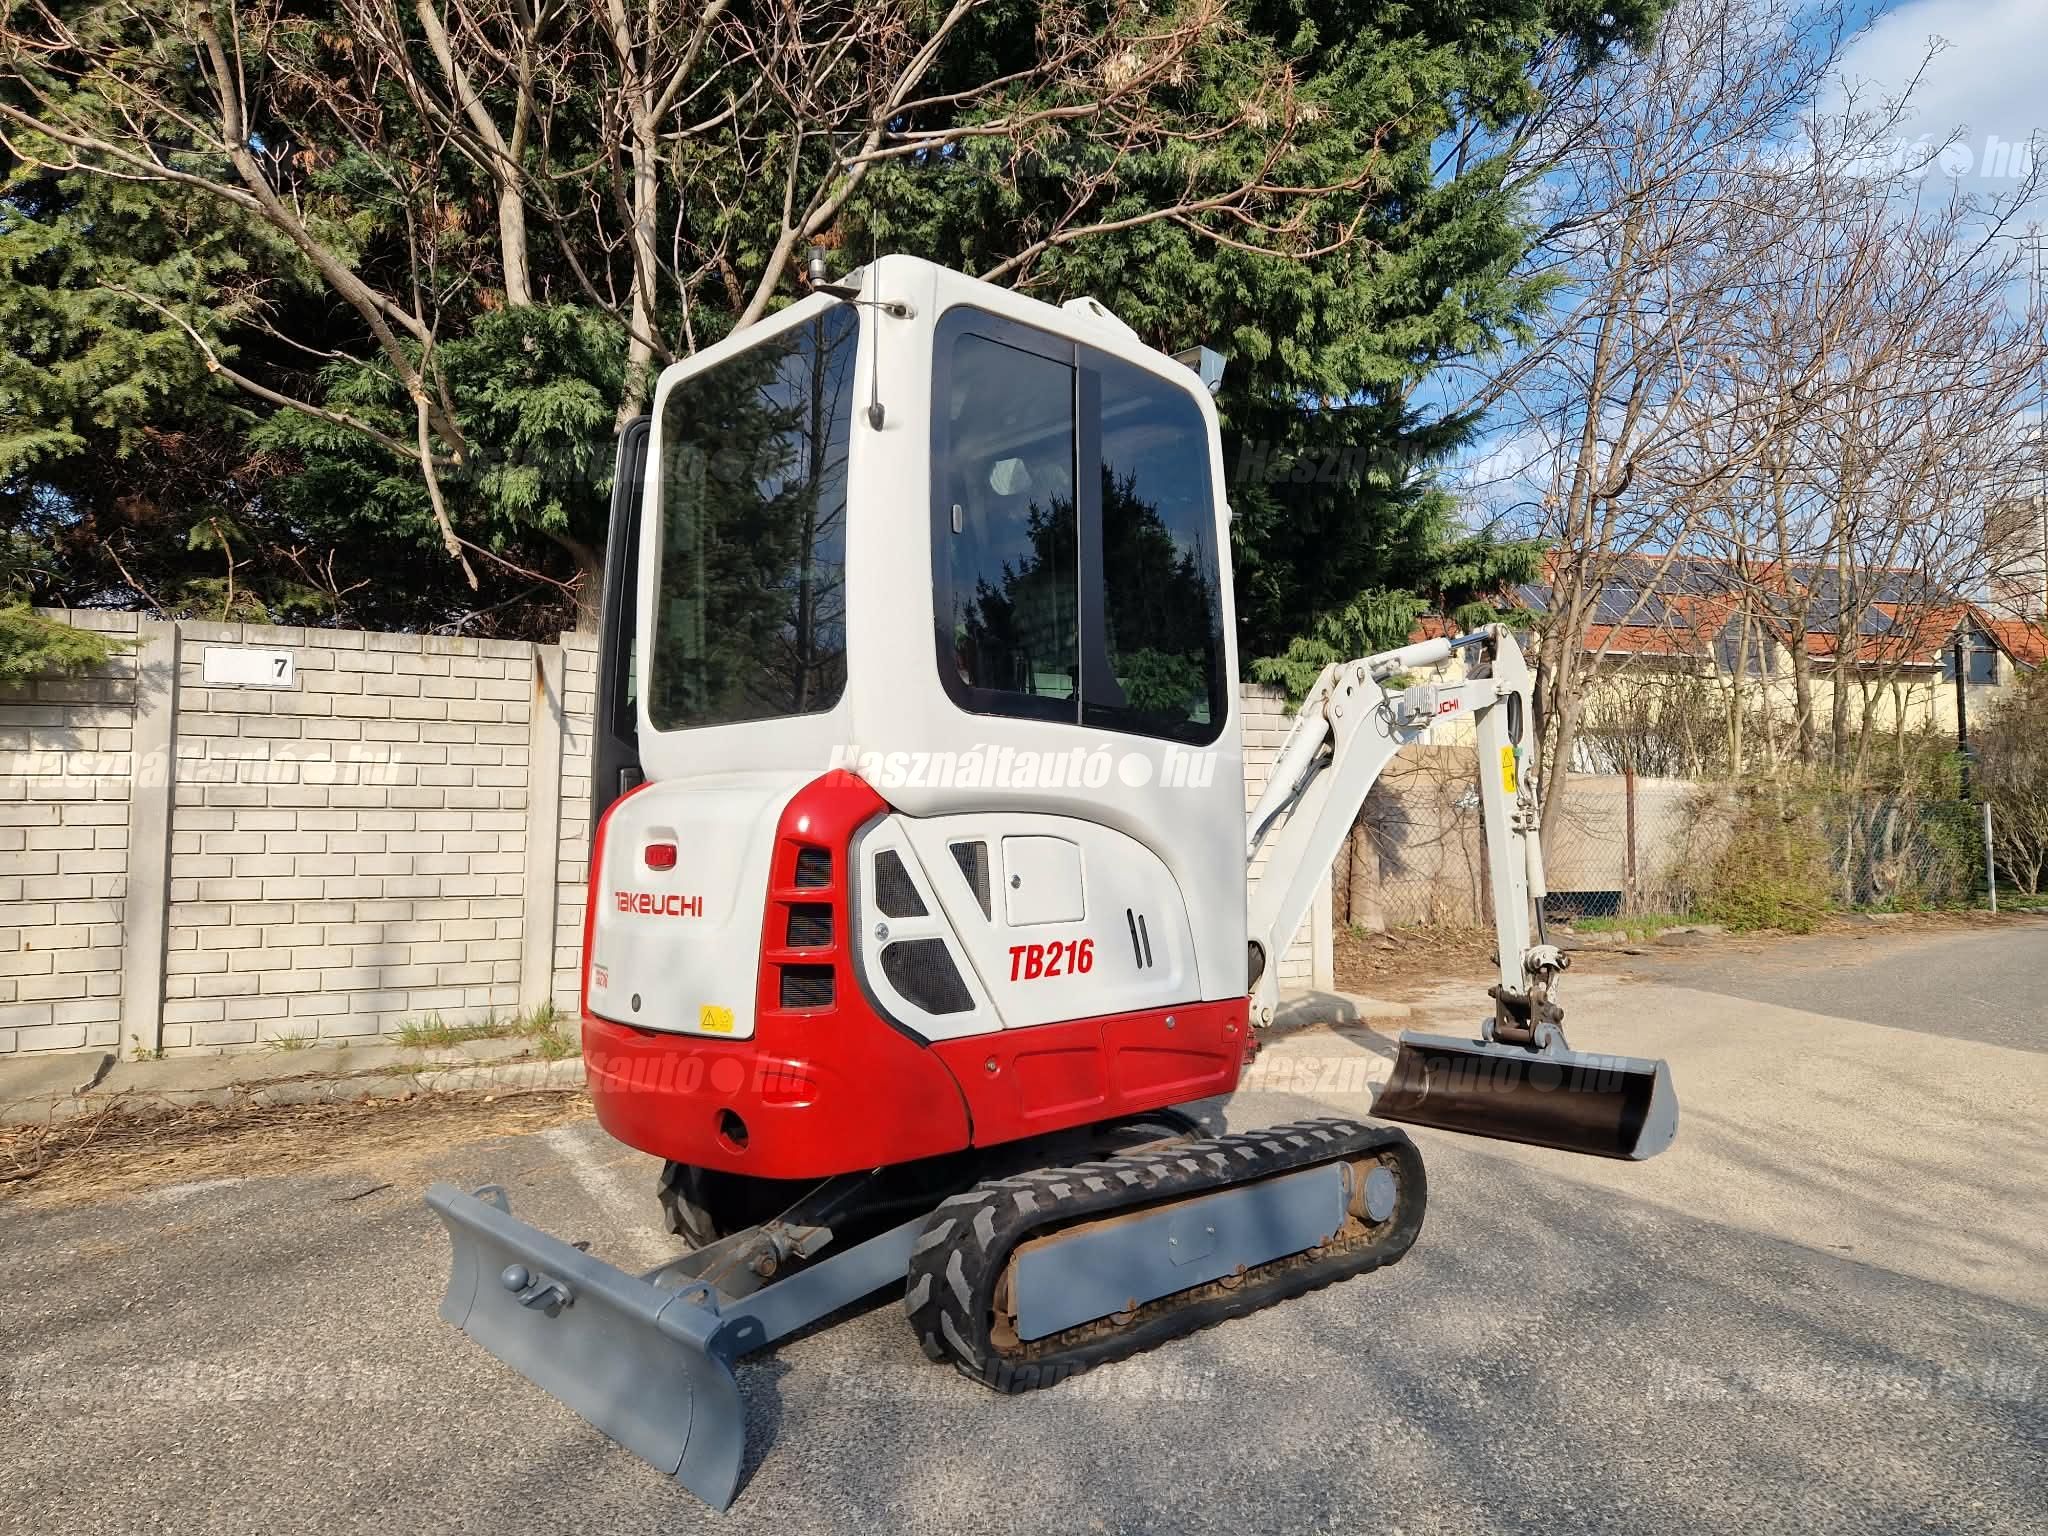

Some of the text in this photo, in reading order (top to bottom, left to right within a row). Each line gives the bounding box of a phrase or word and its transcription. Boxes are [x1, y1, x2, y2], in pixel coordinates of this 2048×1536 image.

[274, 658, 288, 677] 7
[615, 891, 702, 917] TAKEUCHI
[1009, 938, 1094, 981] TB216
